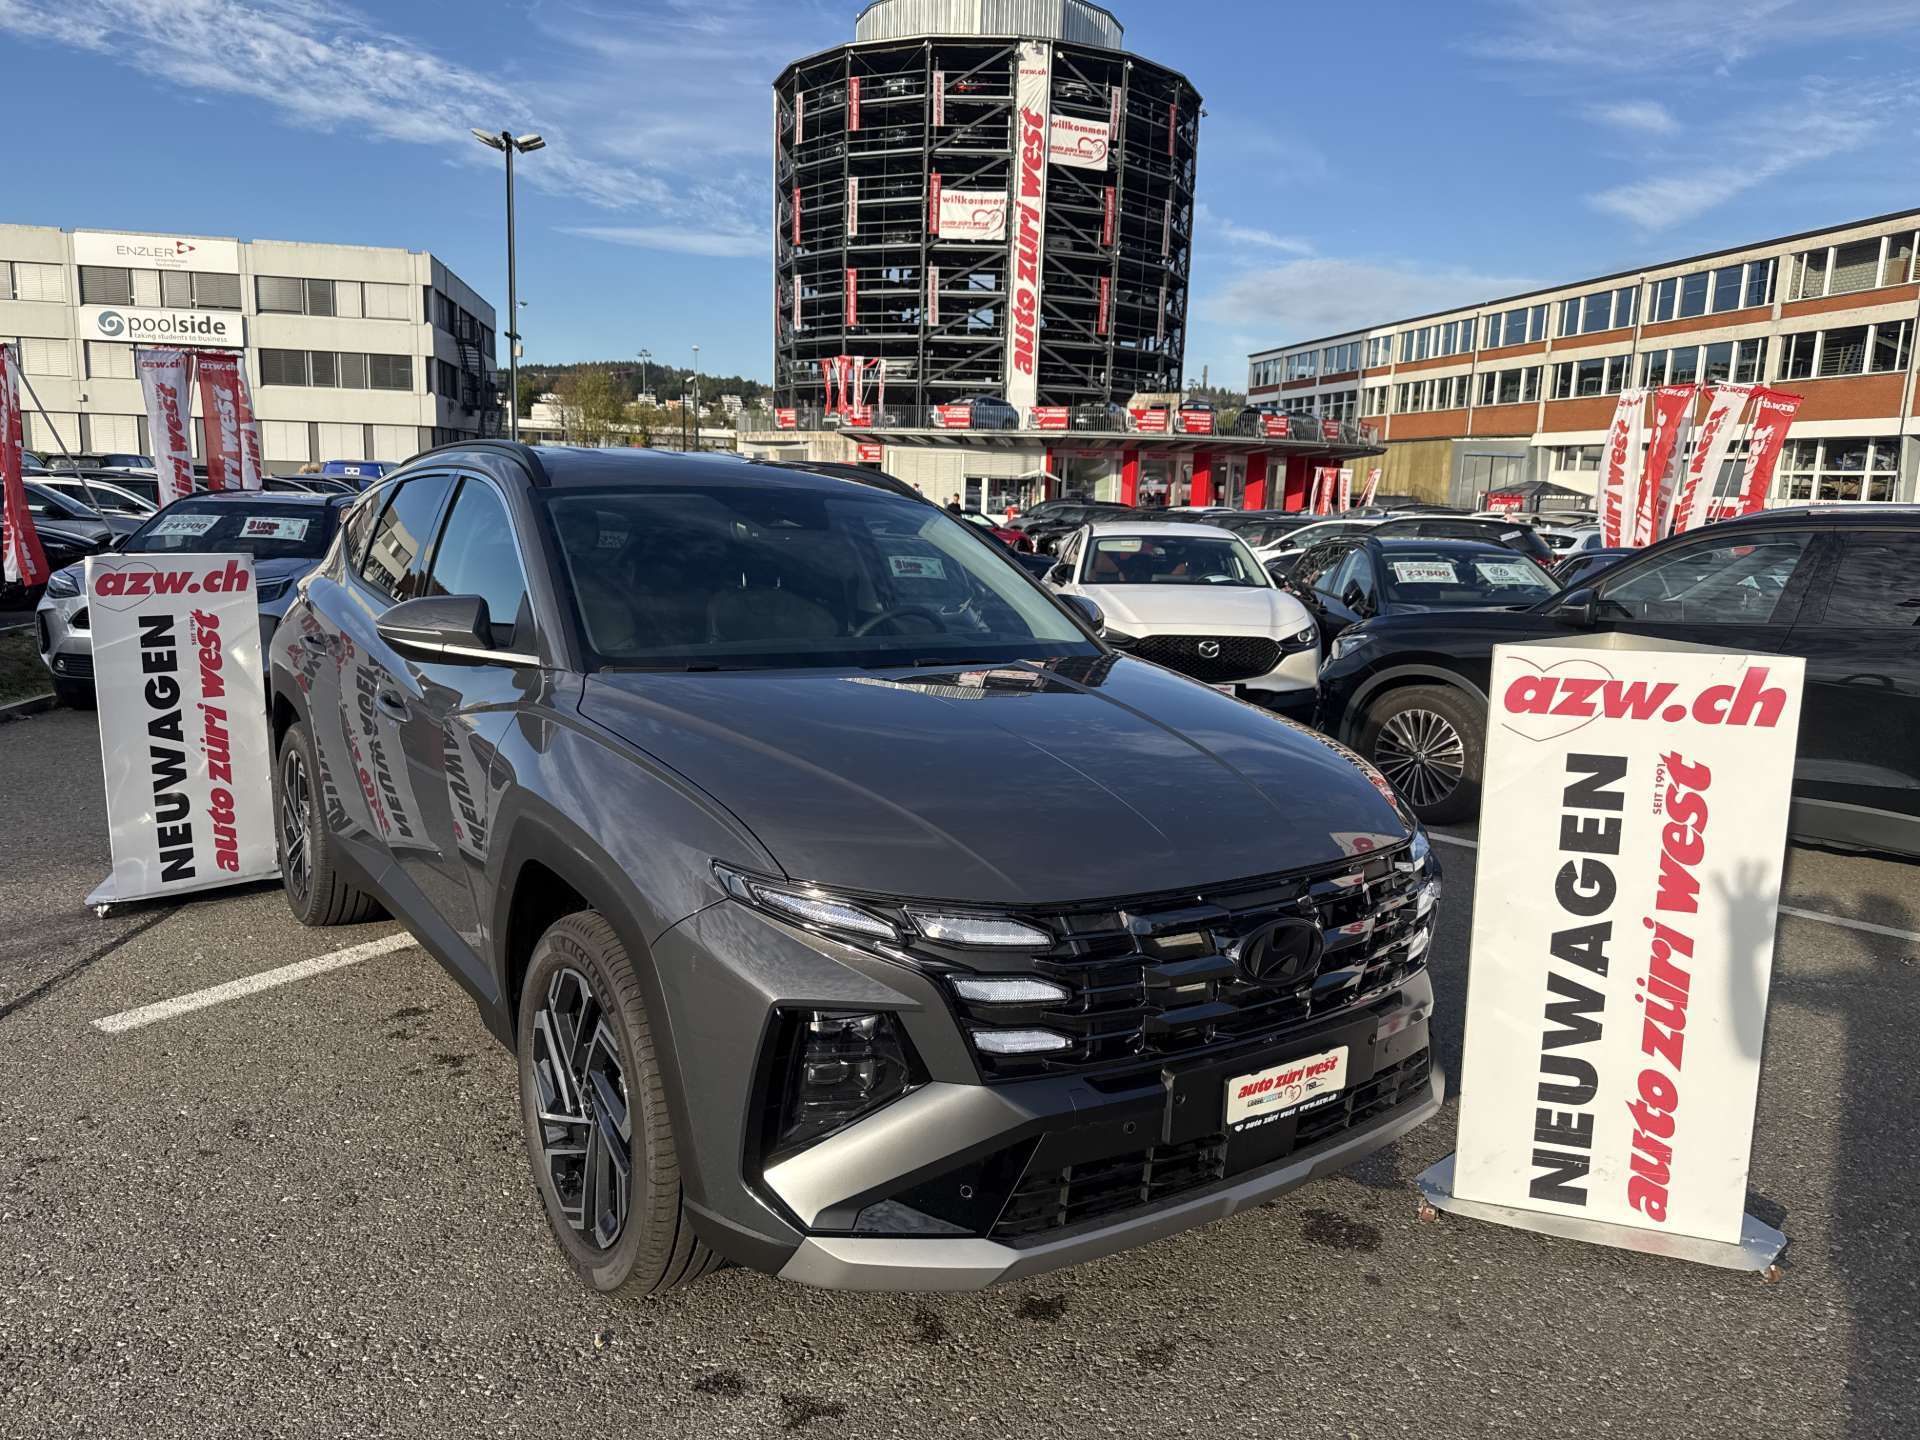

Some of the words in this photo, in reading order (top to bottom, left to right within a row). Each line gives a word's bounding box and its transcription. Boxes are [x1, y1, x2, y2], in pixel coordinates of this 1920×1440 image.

[1021, 106, 1045, 197] west
[1050, 120, 1108, 136] willkommen
[942, 194, 1005, 206] willkommen
[116, 245, 175, 258] ENZLER
[1014, 200, 1041, 288] züri
[128, 314, 226, 338] poolside
[134, 333, 156, 341] taking
[158, 333, 188, 341] students
[1012, 288, 1036, 375] auto
[159, 383, 188, 451] west
[1607, 419, 1630, 486] west
[95, 560, 250, 596] azw.ch
[190, 609, 226, 699] west
[1504, 666, 1788, 728] azw.ch
[138, 614, 197, 883] NEUWAGEN
[197, 703, 232, 786] züri
[1656, 763, 1666, 788] 1991
[207, 788, 240, 873] auto
[1653, 792, 1664, 816] SEIT
[1656, 750, 1713, 915] west
[1528, 753, 1629, 1208] NEUWAGEN
[1634, 916, 1695, 1073] züri
[1238, 1077, 1275, 1099] auto
[1274, 1065, 1306, 1088] züri
[1305, 1055, 1339, 1078] west
[1623, 1068, 1679, 1223] auto
